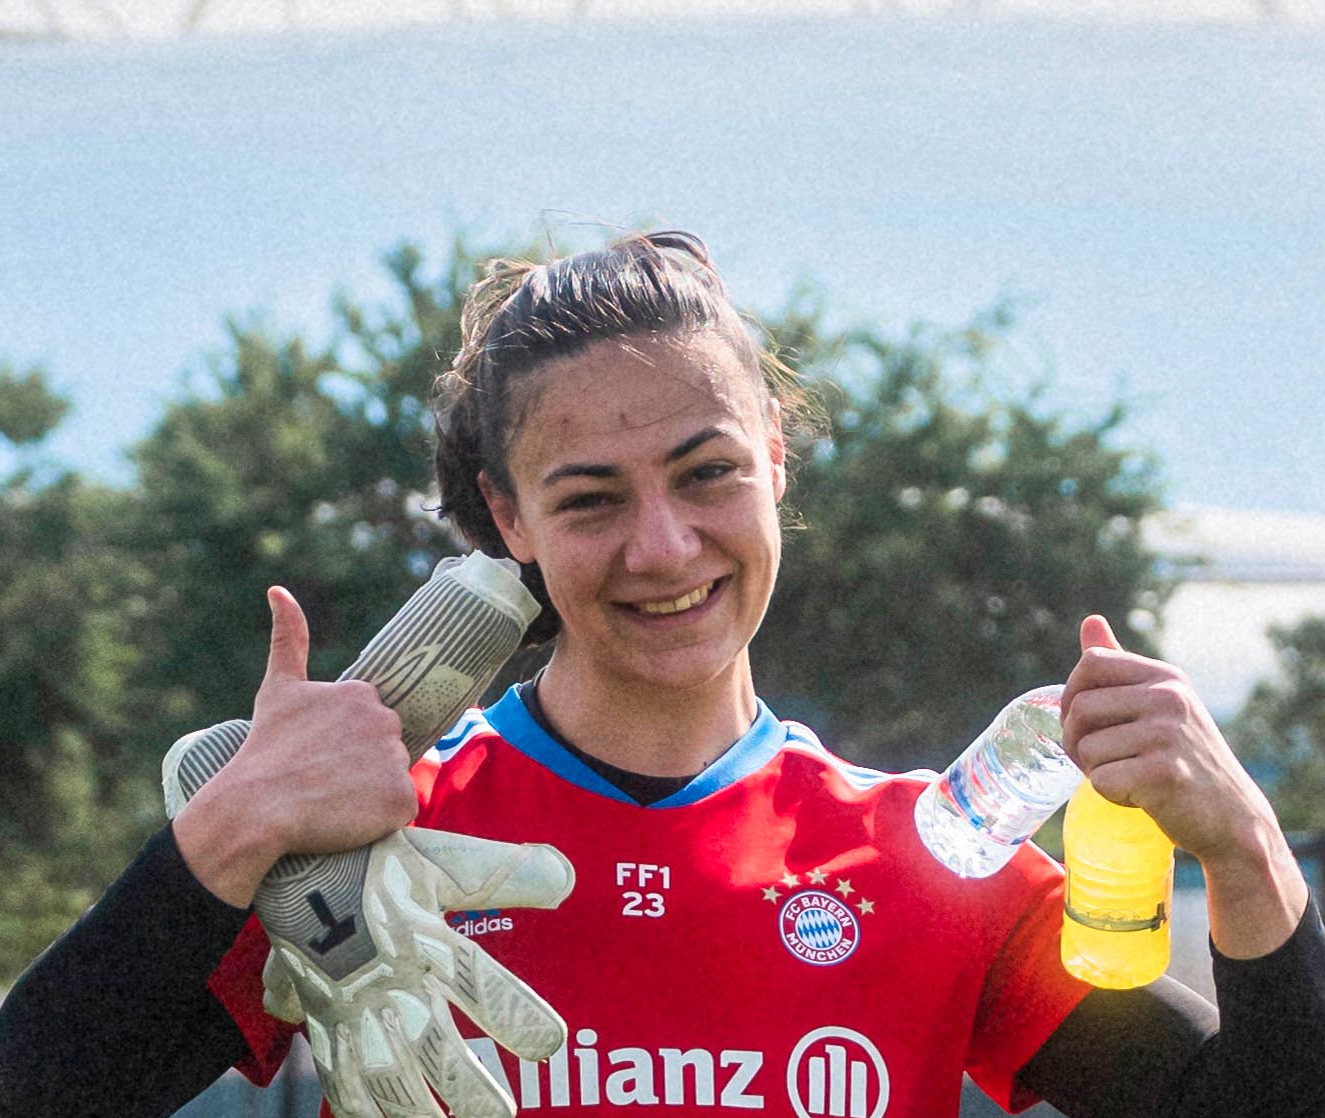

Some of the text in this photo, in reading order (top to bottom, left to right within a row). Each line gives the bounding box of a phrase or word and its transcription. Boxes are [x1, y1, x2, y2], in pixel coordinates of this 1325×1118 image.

[616, 862, 671, 889] FF1
[622, 891, 666, 918] 23
[785, 896, 853, 927] FC BAYERN
[452, 917, 514, 937] didas
